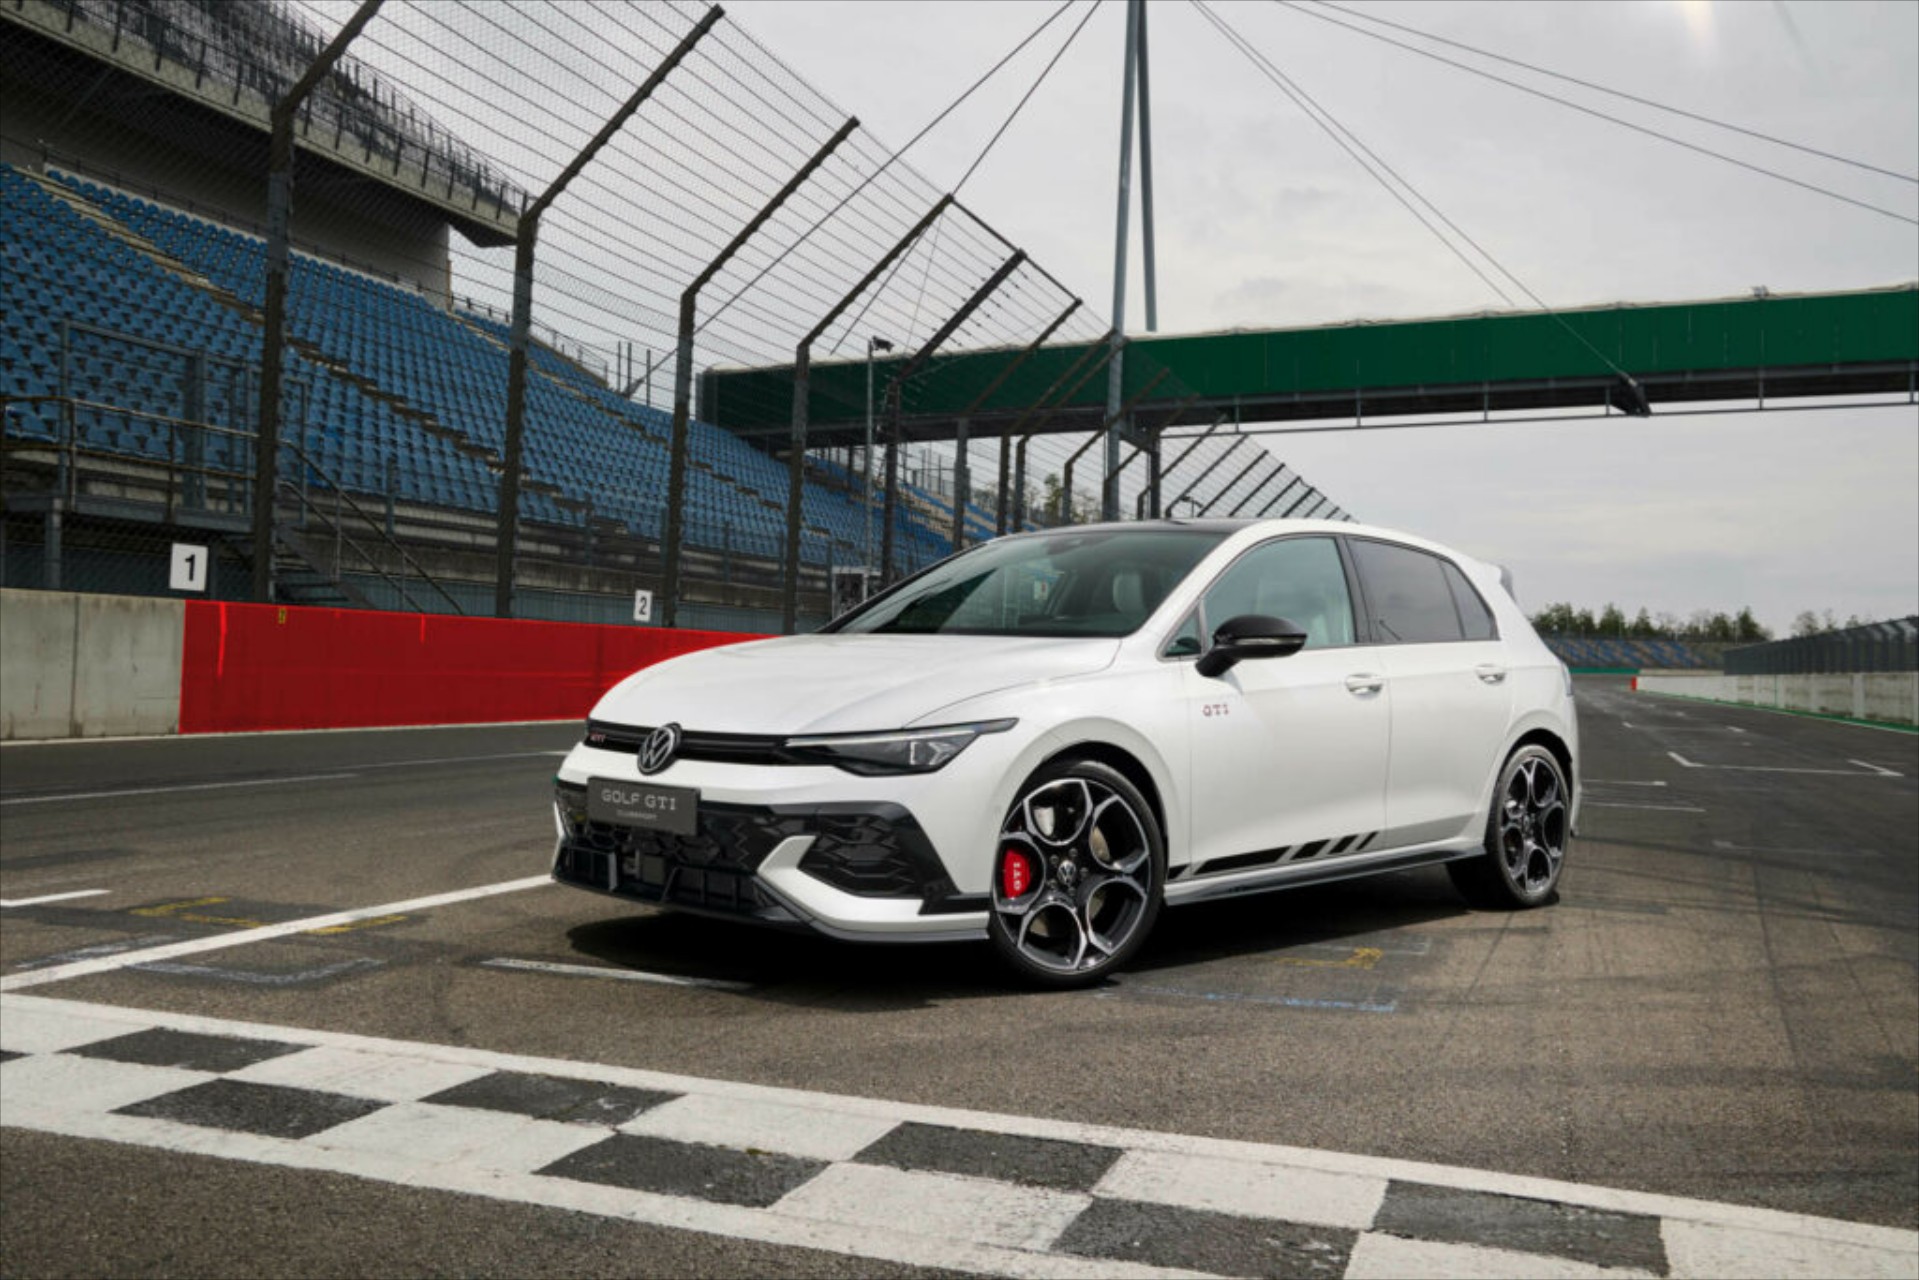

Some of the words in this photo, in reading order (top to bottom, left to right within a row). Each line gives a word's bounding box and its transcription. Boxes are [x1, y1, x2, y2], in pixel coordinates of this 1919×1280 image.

[185, 553, 195, 581] 1
[639, 596, 647, 615] 2
[601, 788, 640, 804] GOLF
[646, 794, 676, 810] GTI
